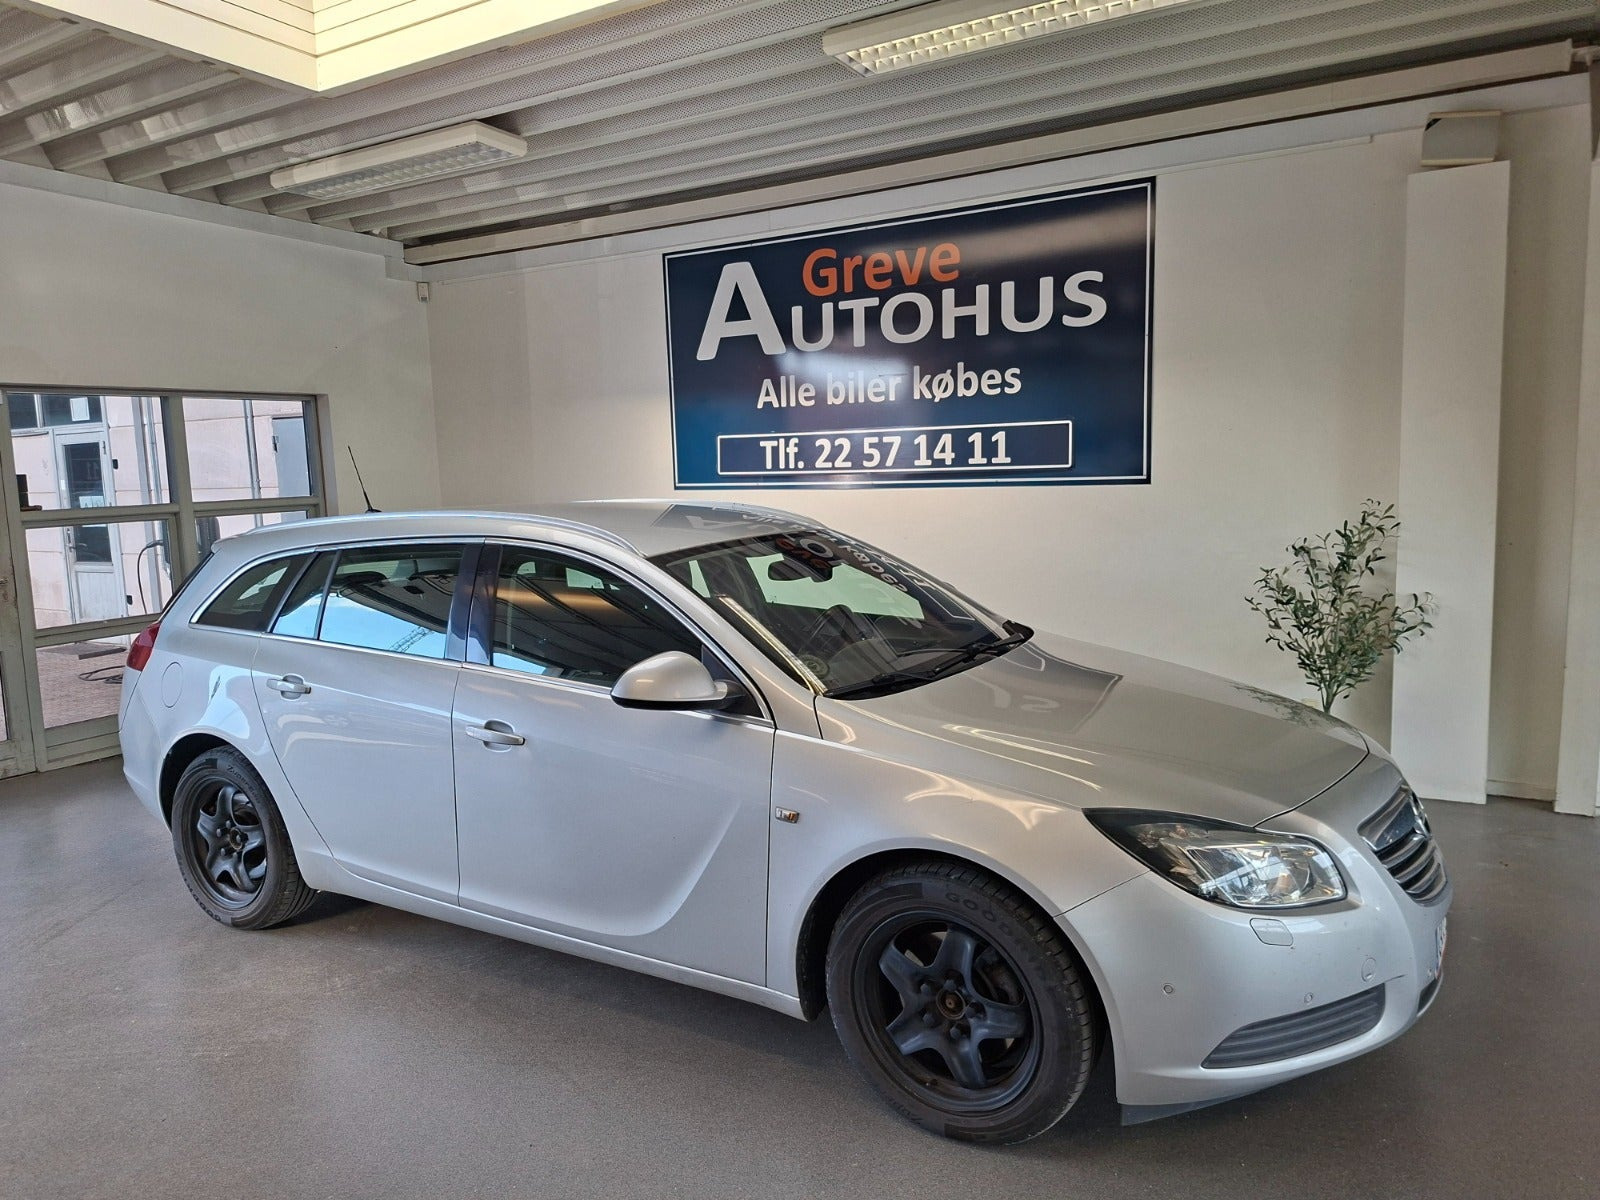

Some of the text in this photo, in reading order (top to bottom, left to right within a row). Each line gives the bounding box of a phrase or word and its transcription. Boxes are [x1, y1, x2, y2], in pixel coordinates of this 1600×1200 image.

[802, 241, 961, 297] Greve
[696, 260, 1108, 362] AUTOHUS
[757, 362, 1022, 409] Alle biler købes
[759, 430, 1012, 470] Tlf. 22 57 14 11
